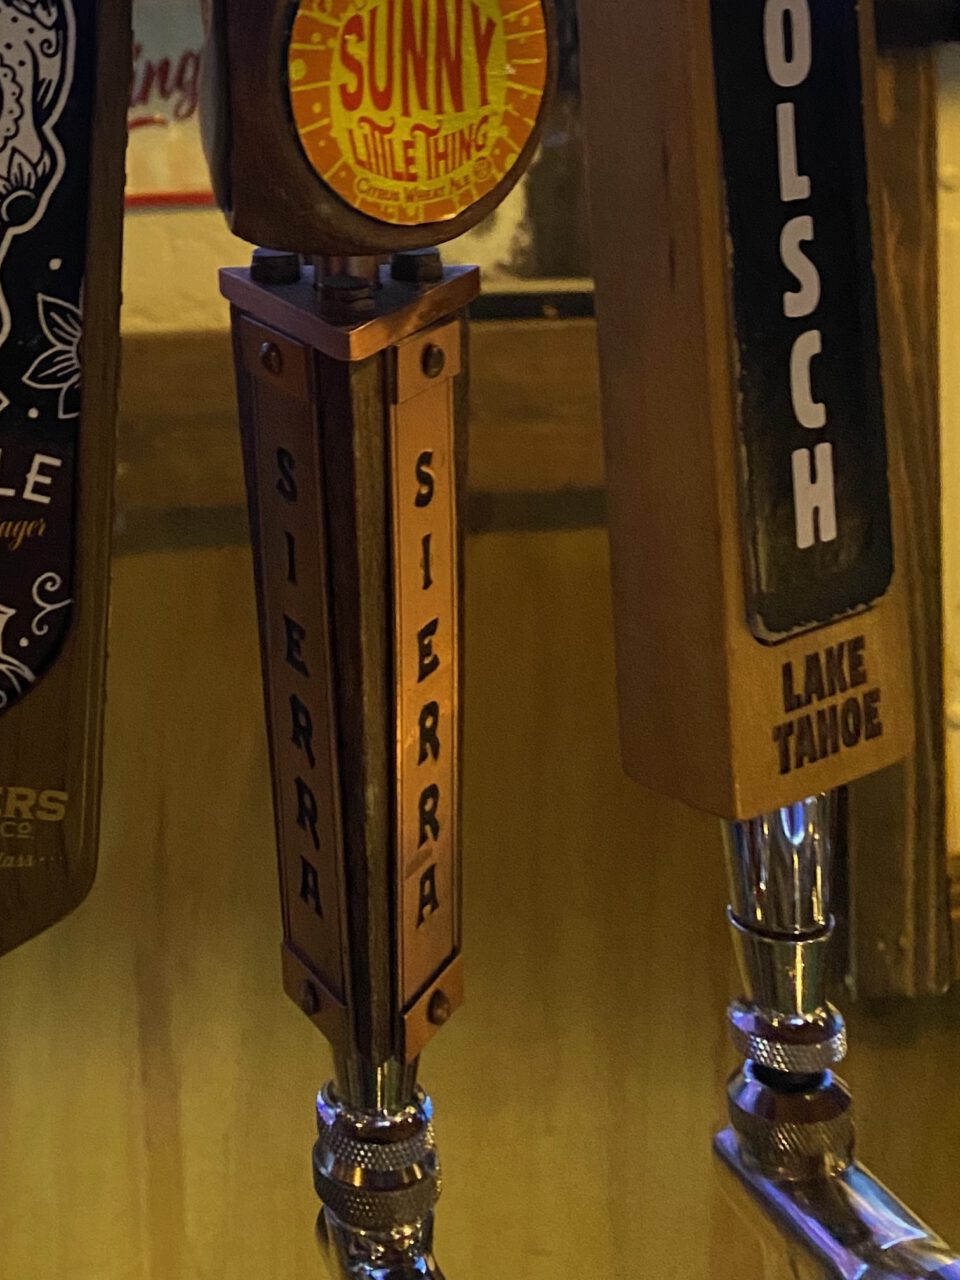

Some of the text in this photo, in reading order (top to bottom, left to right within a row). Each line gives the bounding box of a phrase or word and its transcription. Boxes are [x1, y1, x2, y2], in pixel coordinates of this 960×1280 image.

[346, 114, 490, 183] LITTLE THING
[274, 445, 324, 920] SIERRA
[412, 448, 442, 931] SIERRA
[781, 634, 868, 714] LAKE
[771, 687, 884, 776] TAHOE
